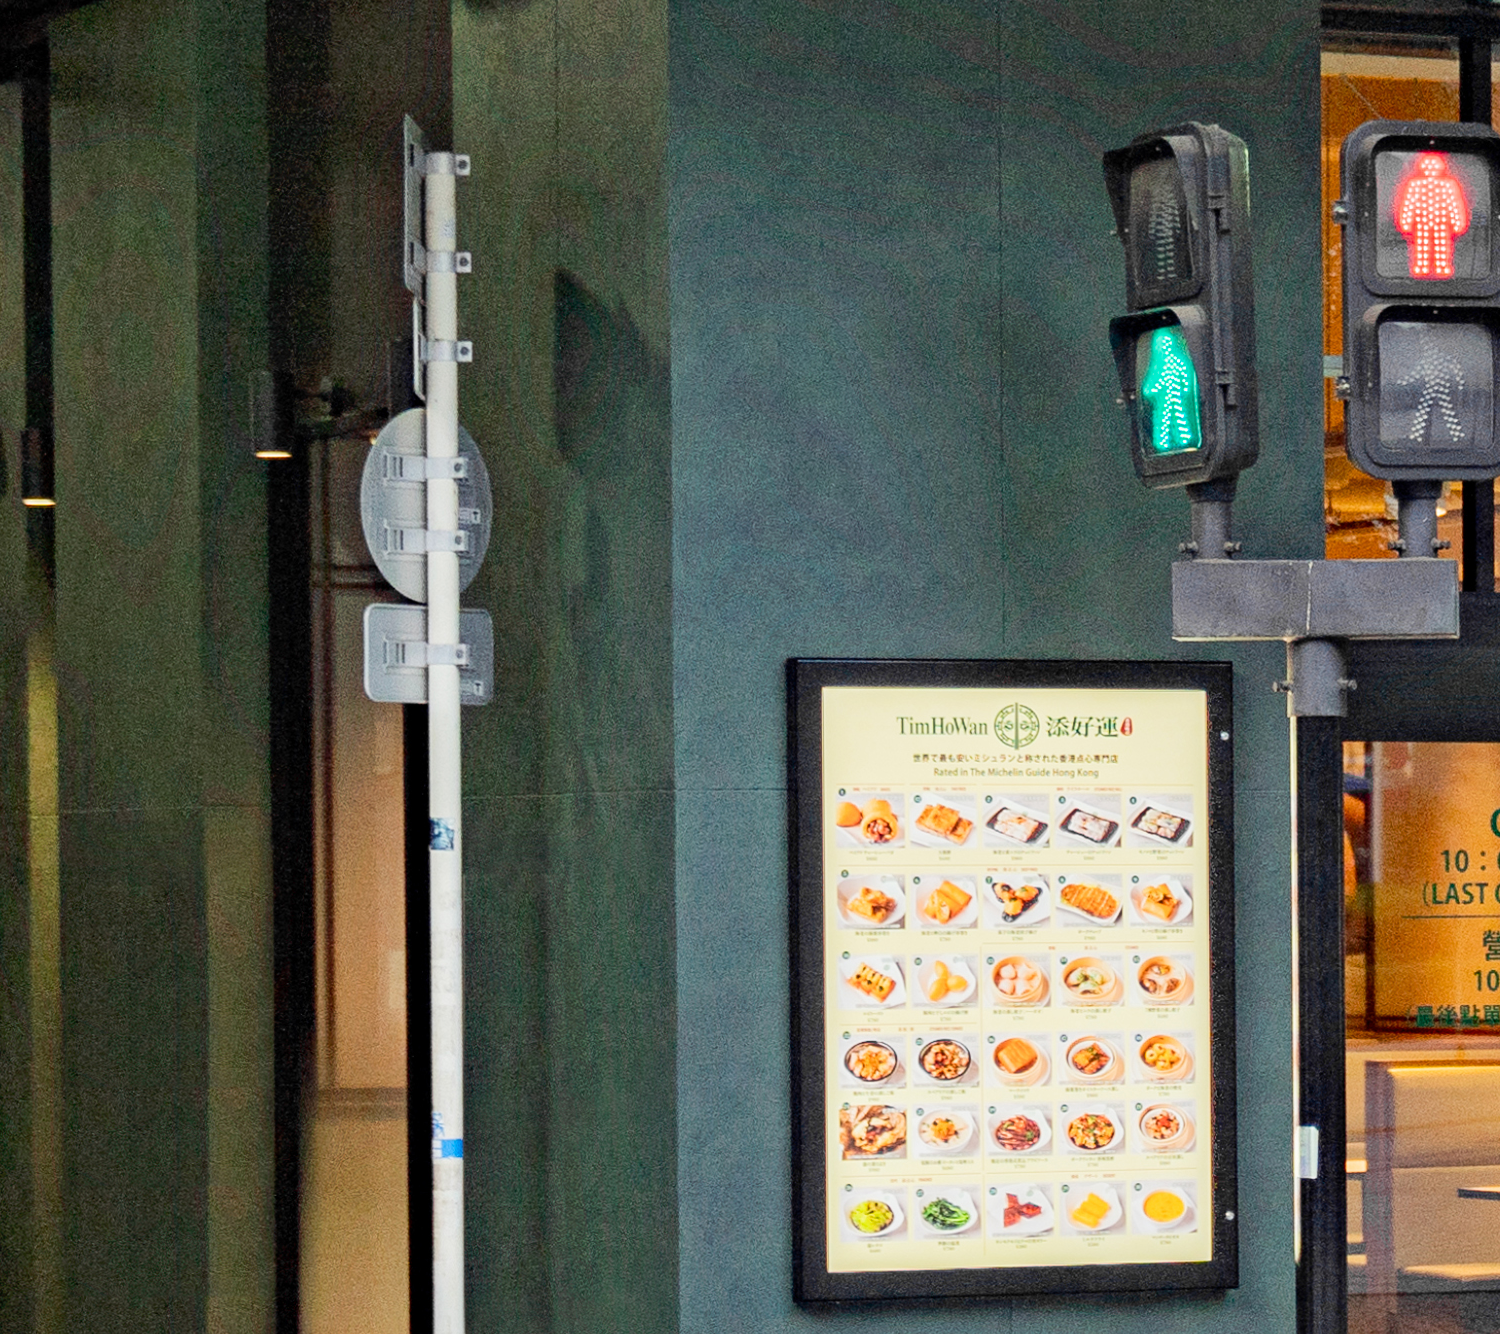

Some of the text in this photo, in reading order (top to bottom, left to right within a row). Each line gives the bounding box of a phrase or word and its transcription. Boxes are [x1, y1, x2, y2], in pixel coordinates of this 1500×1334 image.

[896, 716, 989, 736] TimHoWan
[1045, 715, 1119, 738] 添好運
[933, 767, 1100, 779] Rated in The Michelin Guide Hong Kong
